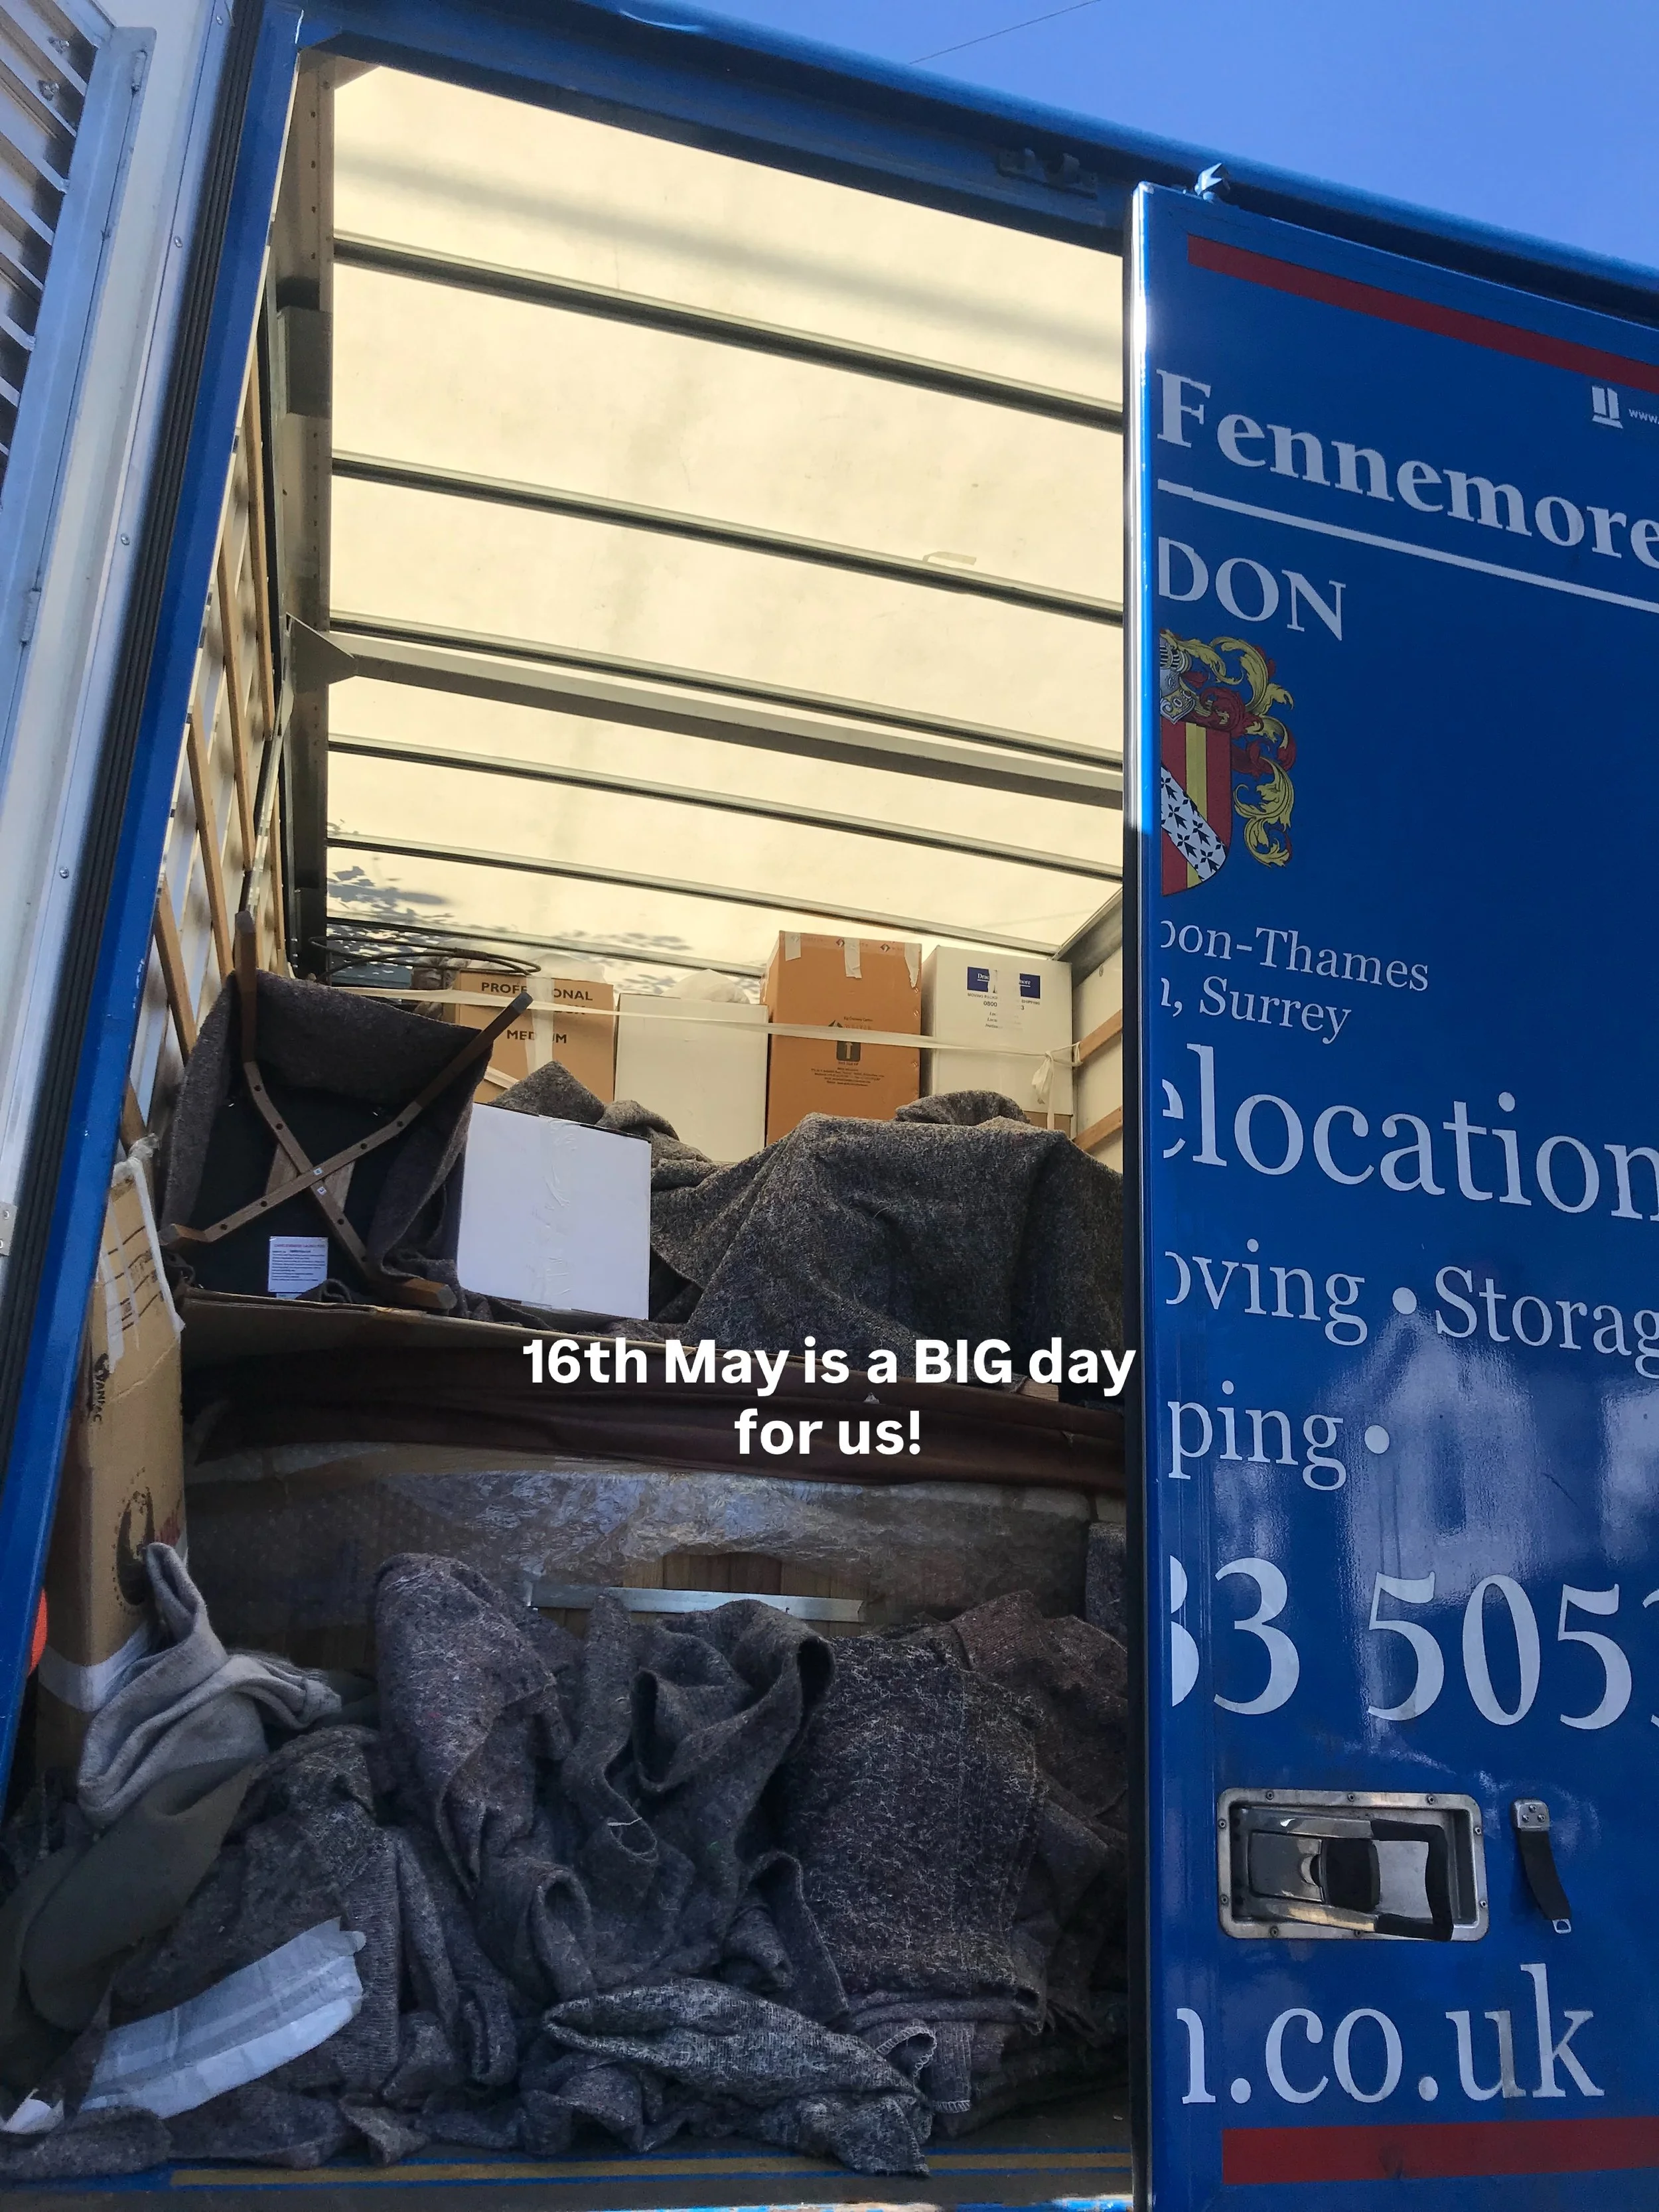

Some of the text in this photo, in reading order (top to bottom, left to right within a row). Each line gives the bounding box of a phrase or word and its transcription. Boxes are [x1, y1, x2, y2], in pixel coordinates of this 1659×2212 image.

[1156, 369, 1659, 569] Fennemore
[1199, 976, 1352, 1045] Surrey
[1167, 1380, 1347, 1491] ping
[1368, 1571, 1659, 1730] 505
